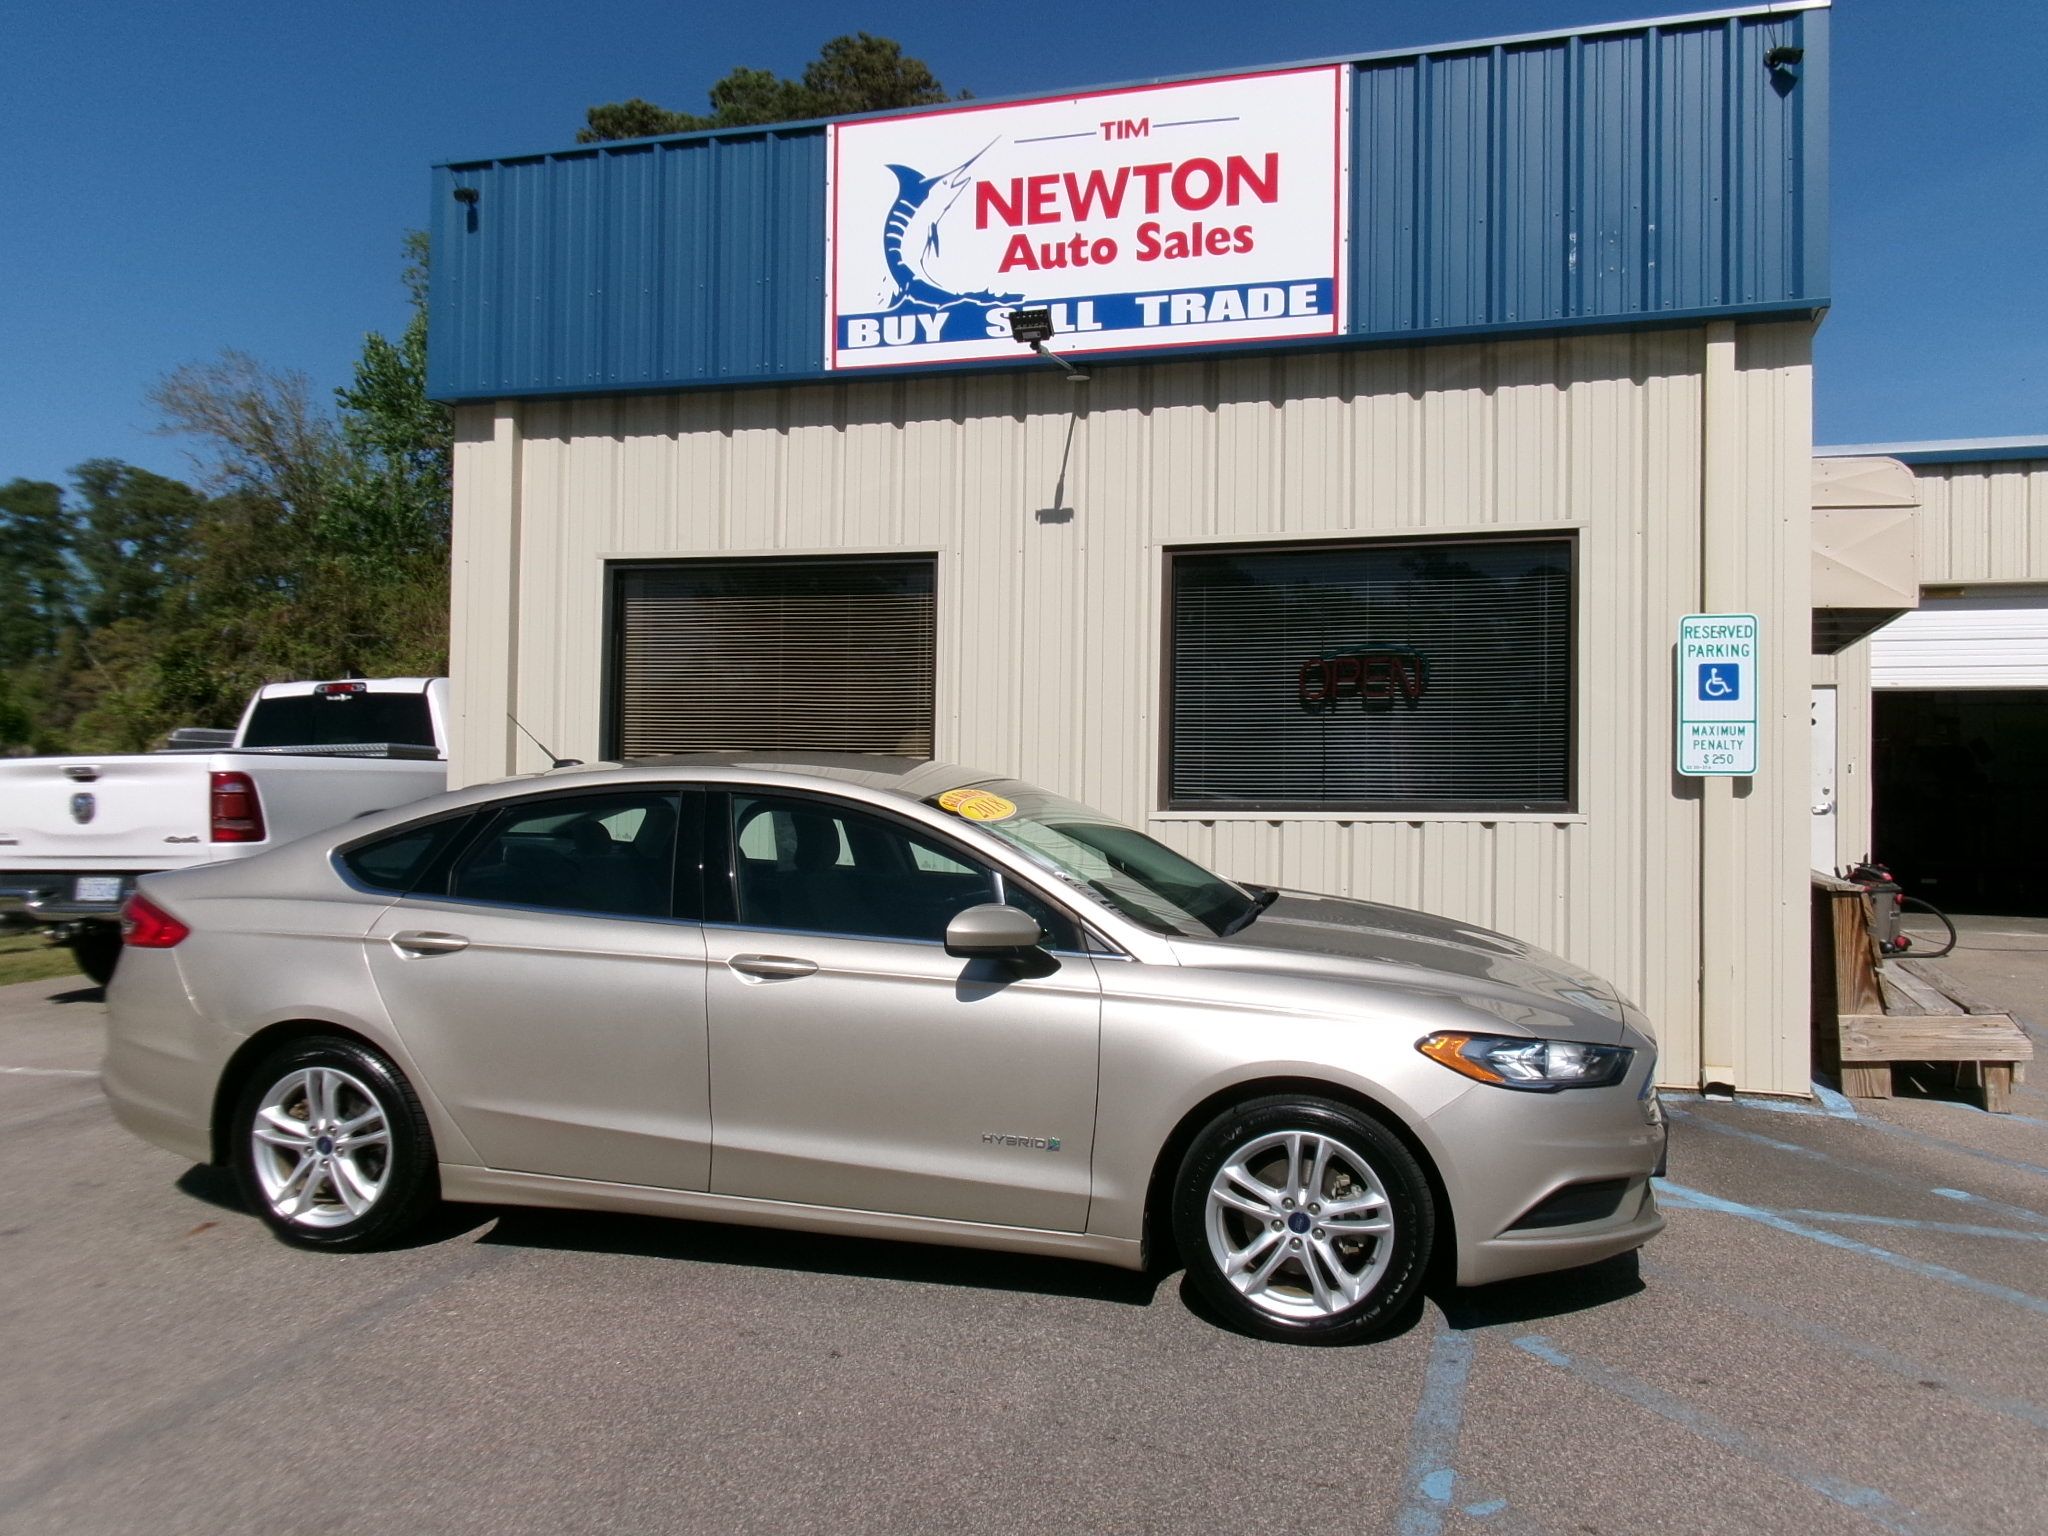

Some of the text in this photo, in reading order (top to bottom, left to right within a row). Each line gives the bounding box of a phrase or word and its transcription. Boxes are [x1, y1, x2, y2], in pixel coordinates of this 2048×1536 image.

[1100, 118, 1149, 141] TIM
[975, 152, 1279, 230] NEWTON
[998, 221, 1254, 273] Auto Sales
[847, 283, 1318, 348] BUY SLL TRADE
[1684, 625, 1753, 639] RESERVED
[1688, 644, 1750, 658] PARKING
[1299, 656, 1421, 699] OPEN
[1692, 726, 1746, 736] MAXIMUM
[1693, 740, 1743, 750] PENALTY
[982, 1133, 1046, 1149] HYBRID
